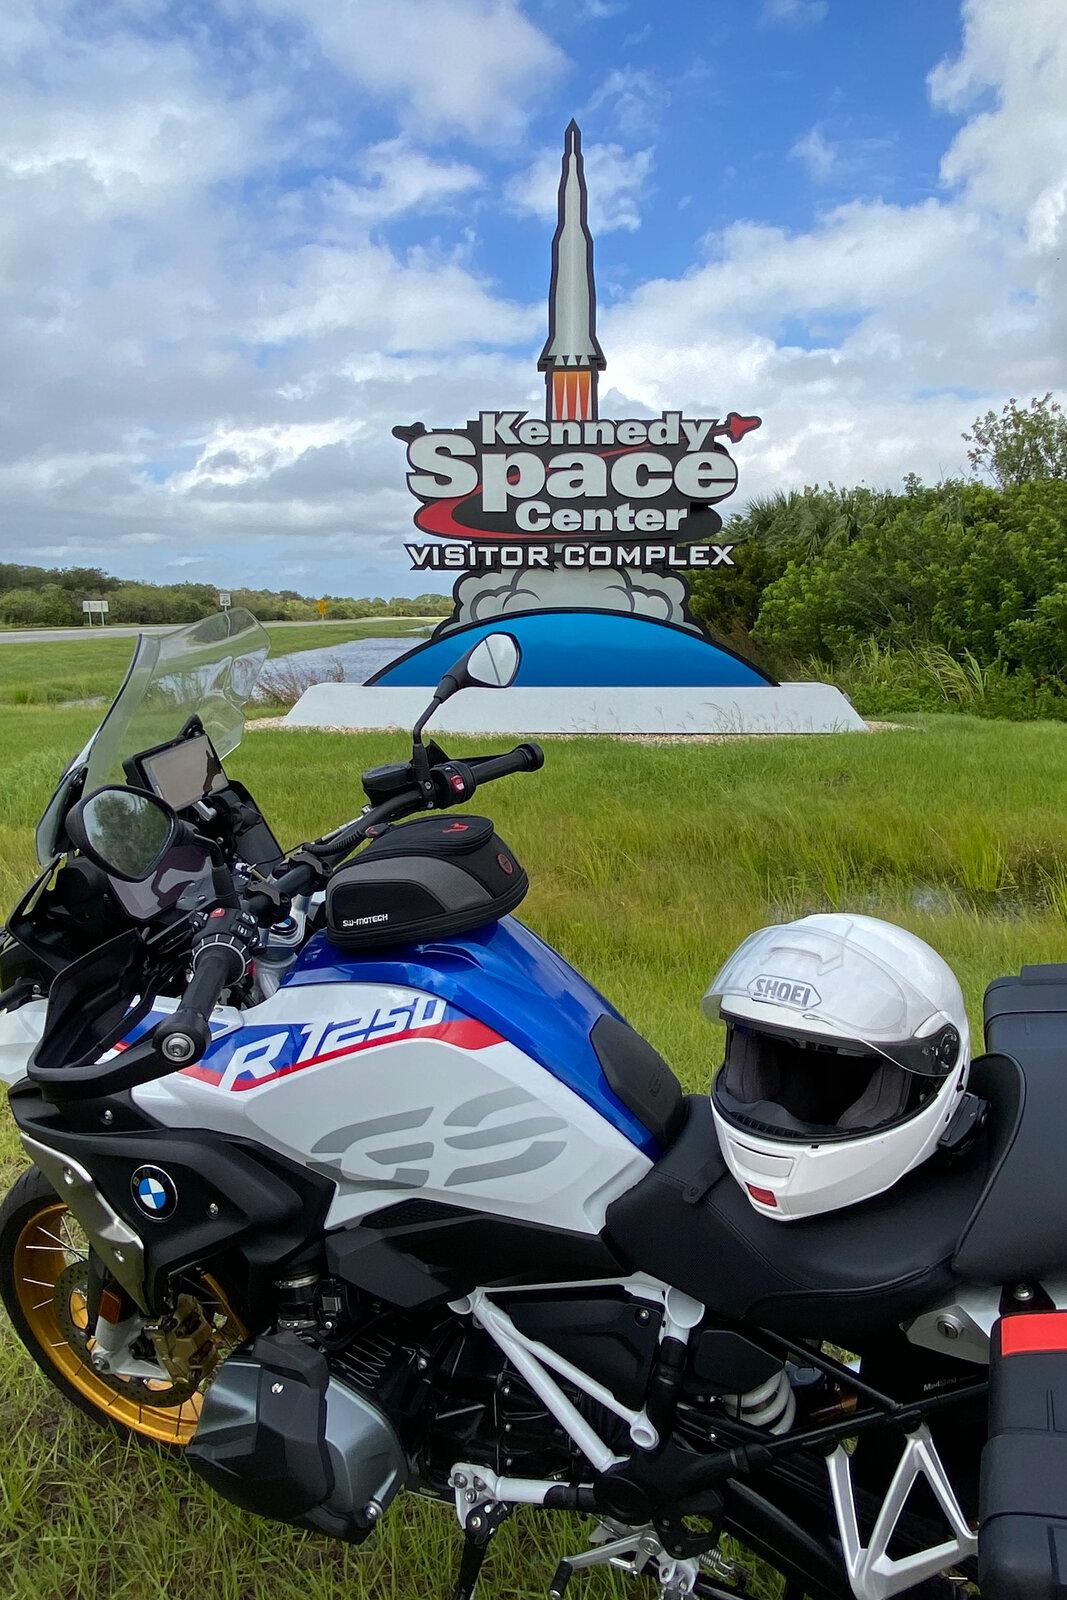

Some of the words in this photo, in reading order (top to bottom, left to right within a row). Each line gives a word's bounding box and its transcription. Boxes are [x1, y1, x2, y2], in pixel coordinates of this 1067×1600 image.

[481, 412, 714, 451] Kennedy
[407, 433, 737, 512] Space
[515, 501, 688, 532] Center
[407, 545, 549, 566] VISITOR
[564, 545, 735, 566] COMPLEX
[342, 913, 389, 927] SW-MOTECH
[753, 978, 811, 1008] SHOEI
[218, 1031, 290, 1092] R
[296, 998, 448, 1064] 1250
